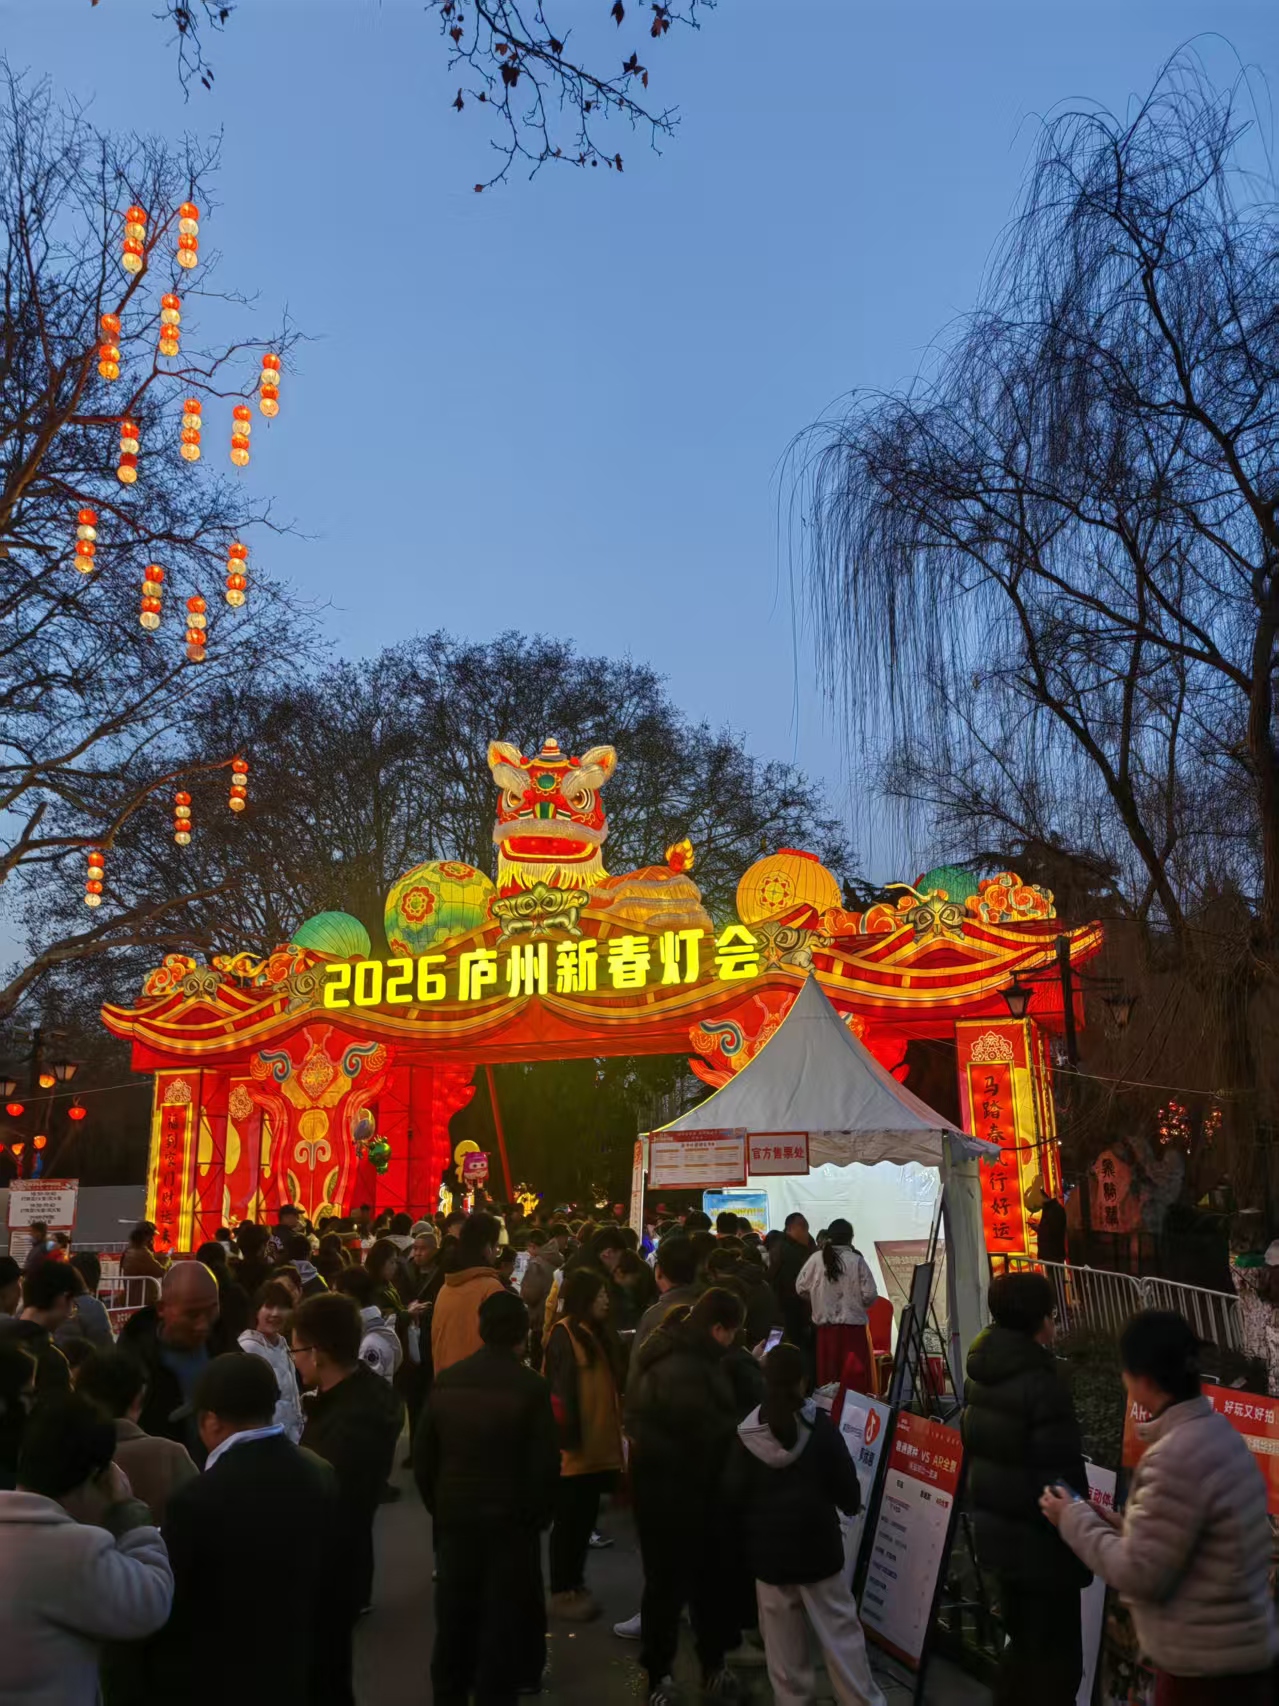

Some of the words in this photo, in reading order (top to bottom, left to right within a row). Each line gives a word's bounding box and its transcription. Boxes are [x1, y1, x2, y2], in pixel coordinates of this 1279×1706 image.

[324, 925, 760, 1008] 2026庐州新春灯会
[752, 1146, 804, 1160] 官方售票处
[921, 1449, 931, 1464] VS
